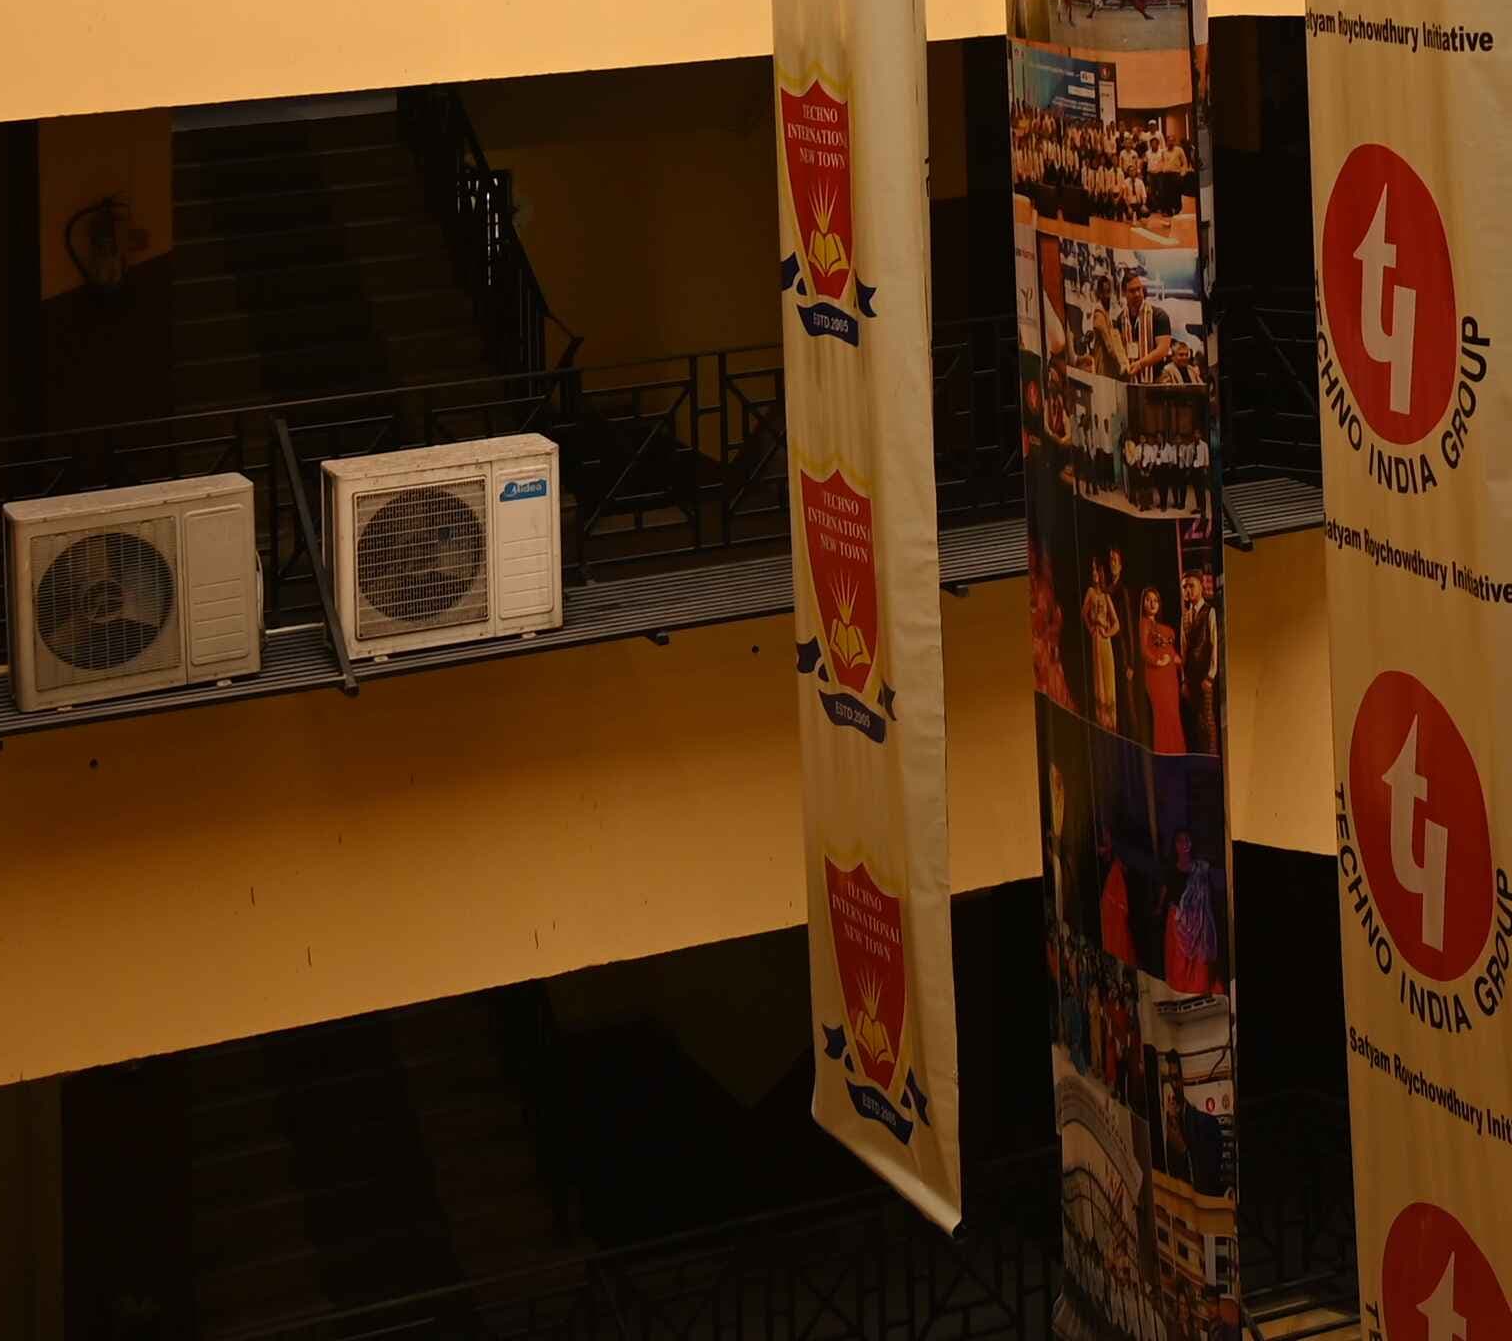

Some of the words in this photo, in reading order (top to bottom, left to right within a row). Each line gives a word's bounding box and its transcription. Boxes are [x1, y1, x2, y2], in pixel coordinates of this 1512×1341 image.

[1423, 22, 1494, 53] Initiative
[802, 103, 838, 123] TECHNO
[799, 147, 816, 166] NEW
[817, 150, 846, 170] TOWN
[1368, 443, 1438, 495] INDIA
[1441, 315, 1491, 470] GROUP
[822, 491, 860, 515] TECHNO
[819, 532, 837, 554] NEW
[838, 539, 869, 565] TOWN
[1364, 528, 1448, 591] Roychowdhury
[846, 881, 883, 912] TECHNO
[1335, 783, 1393, 976] TECHNO
[1400, 970, 1473, 1034] INDIA
[832, 894, 903, 945] INTERNATIONAL
[843, 923, 862, 947] NEW
[863, 932, 891, 963] TOWN
[1349, 1026, 1391, 1077] Satyam
[1394, 1053, 1484, 1136] Roychowdhury
